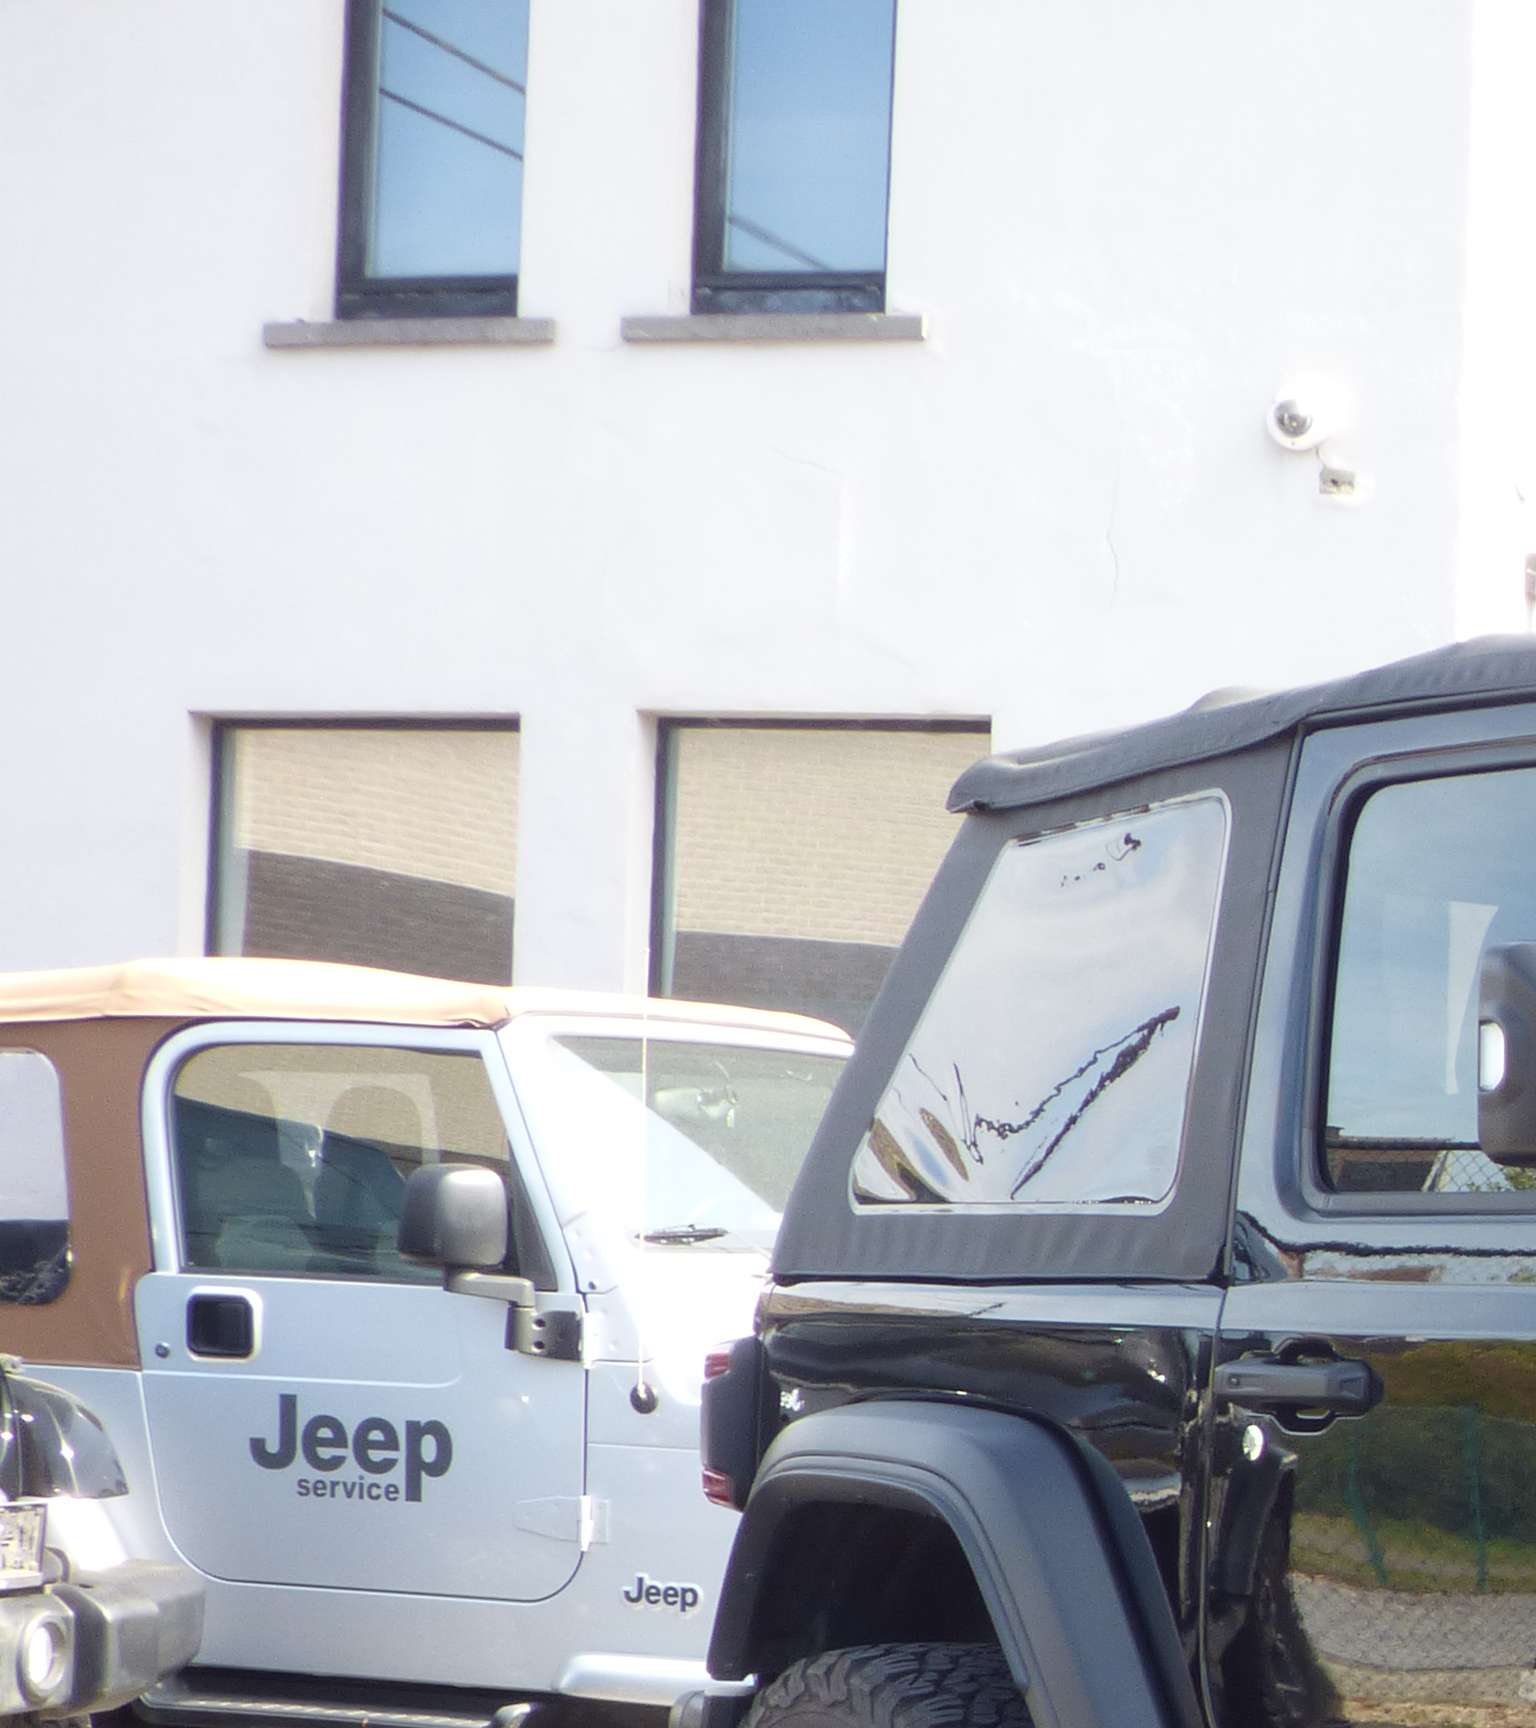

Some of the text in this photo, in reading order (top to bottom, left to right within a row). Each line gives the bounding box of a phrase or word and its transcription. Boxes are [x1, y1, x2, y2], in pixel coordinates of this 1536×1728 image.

[249, 1394, 454, 1503] Jeep
[296, 1474, 400, 1502] service
[623, 1575, 699, 1612] Jeep
